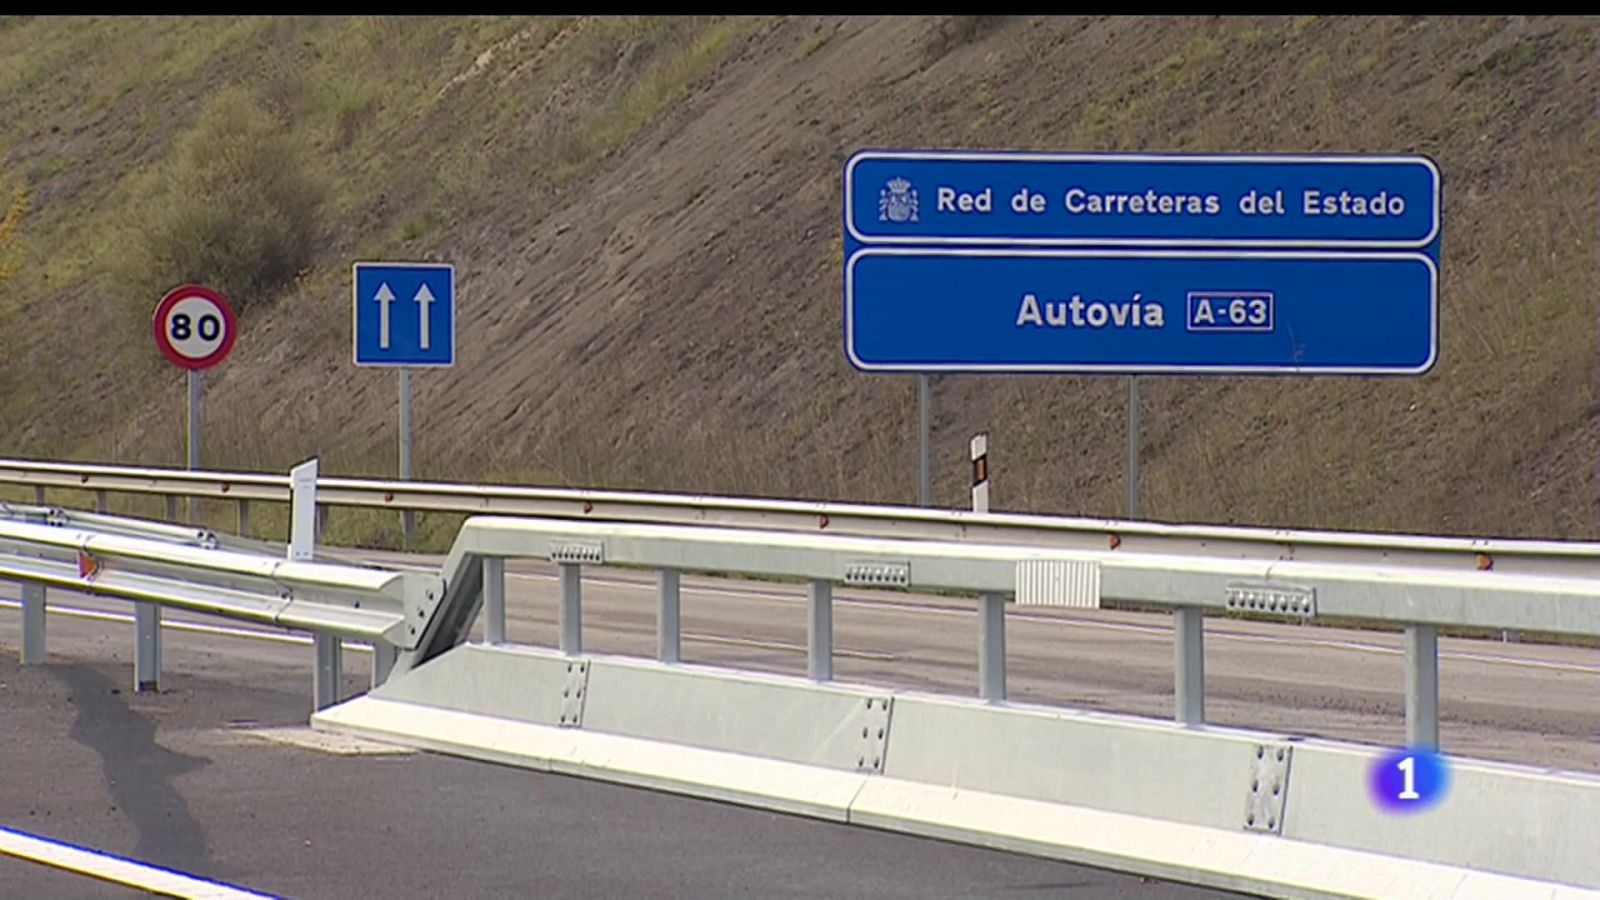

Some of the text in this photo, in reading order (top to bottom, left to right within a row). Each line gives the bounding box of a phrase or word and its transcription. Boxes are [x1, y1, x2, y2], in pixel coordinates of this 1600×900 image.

[939, 188, 1403, 214] Red de Carreteras del Estado
[1017, 295, 1265, 325] Autovía A-63
[171, 313, 220, 341] 80
